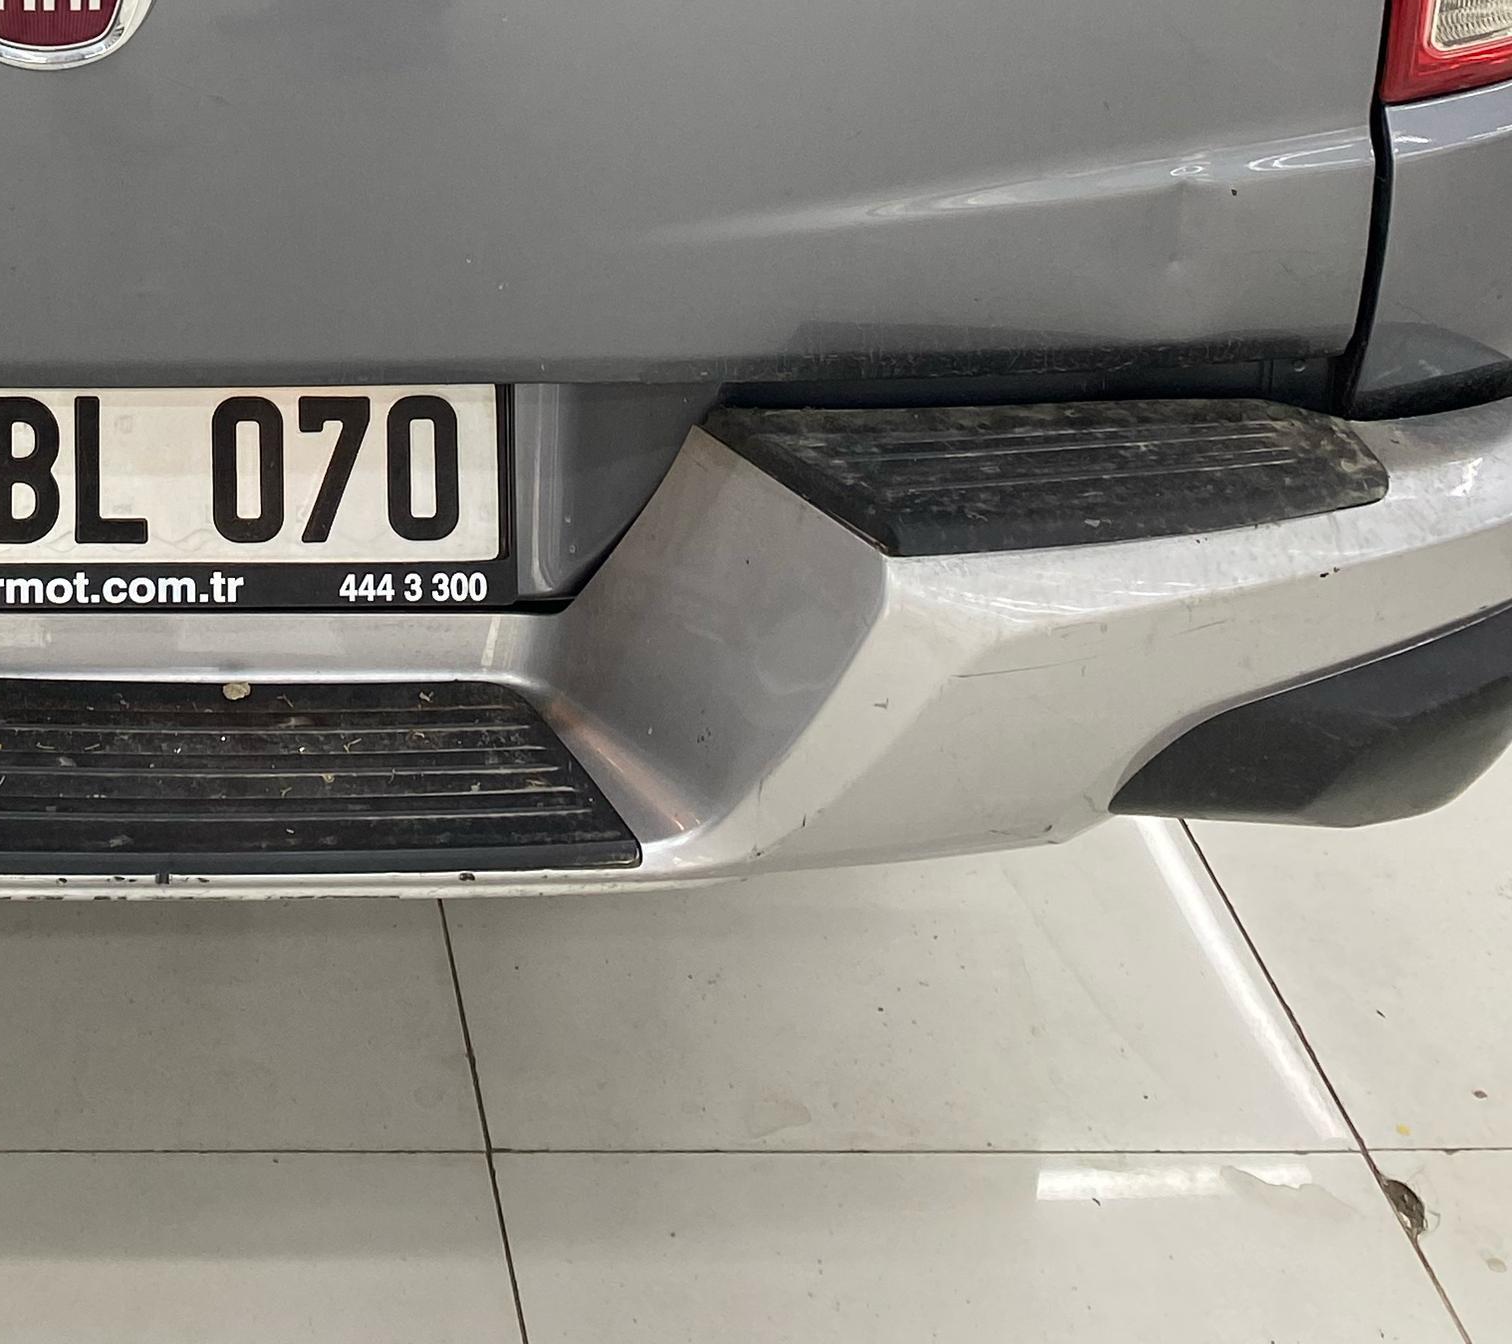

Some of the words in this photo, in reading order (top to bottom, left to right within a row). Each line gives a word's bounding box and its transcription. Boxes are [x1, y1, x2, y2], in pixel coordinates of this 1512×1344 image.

[211, 394, 461, 544] 070
[339, 573, 395, 602] 444
[404, 572, 423, 602] 3
[431, 572, 488, 602] 300
